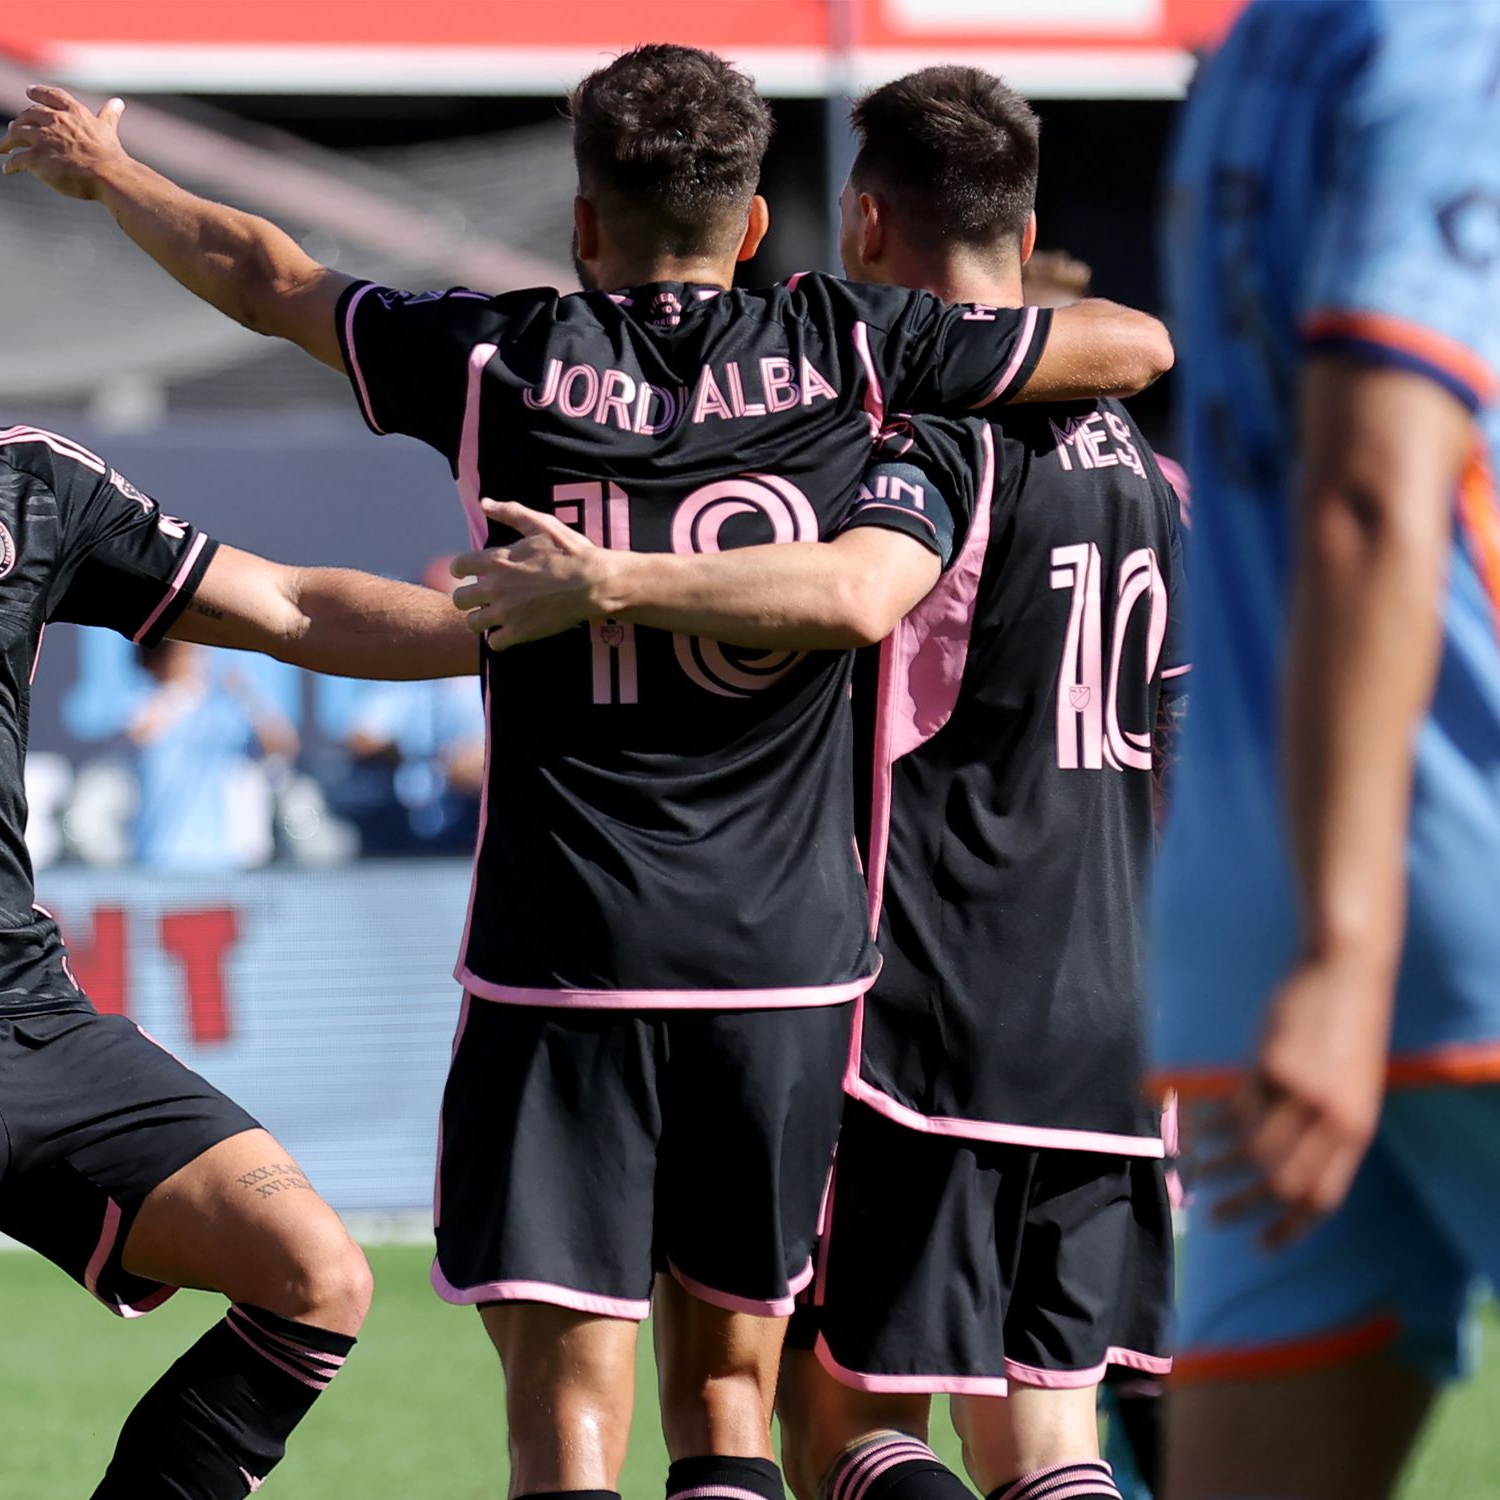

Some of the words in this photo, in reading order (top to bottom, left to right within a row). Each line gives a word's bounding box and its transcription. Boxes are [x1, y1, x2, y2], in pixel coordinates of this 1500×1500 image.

[691, 354, 840, 425] ALBA
[551, 474, 820, 706] 18
[1049, 541, 1168, 773] 10
